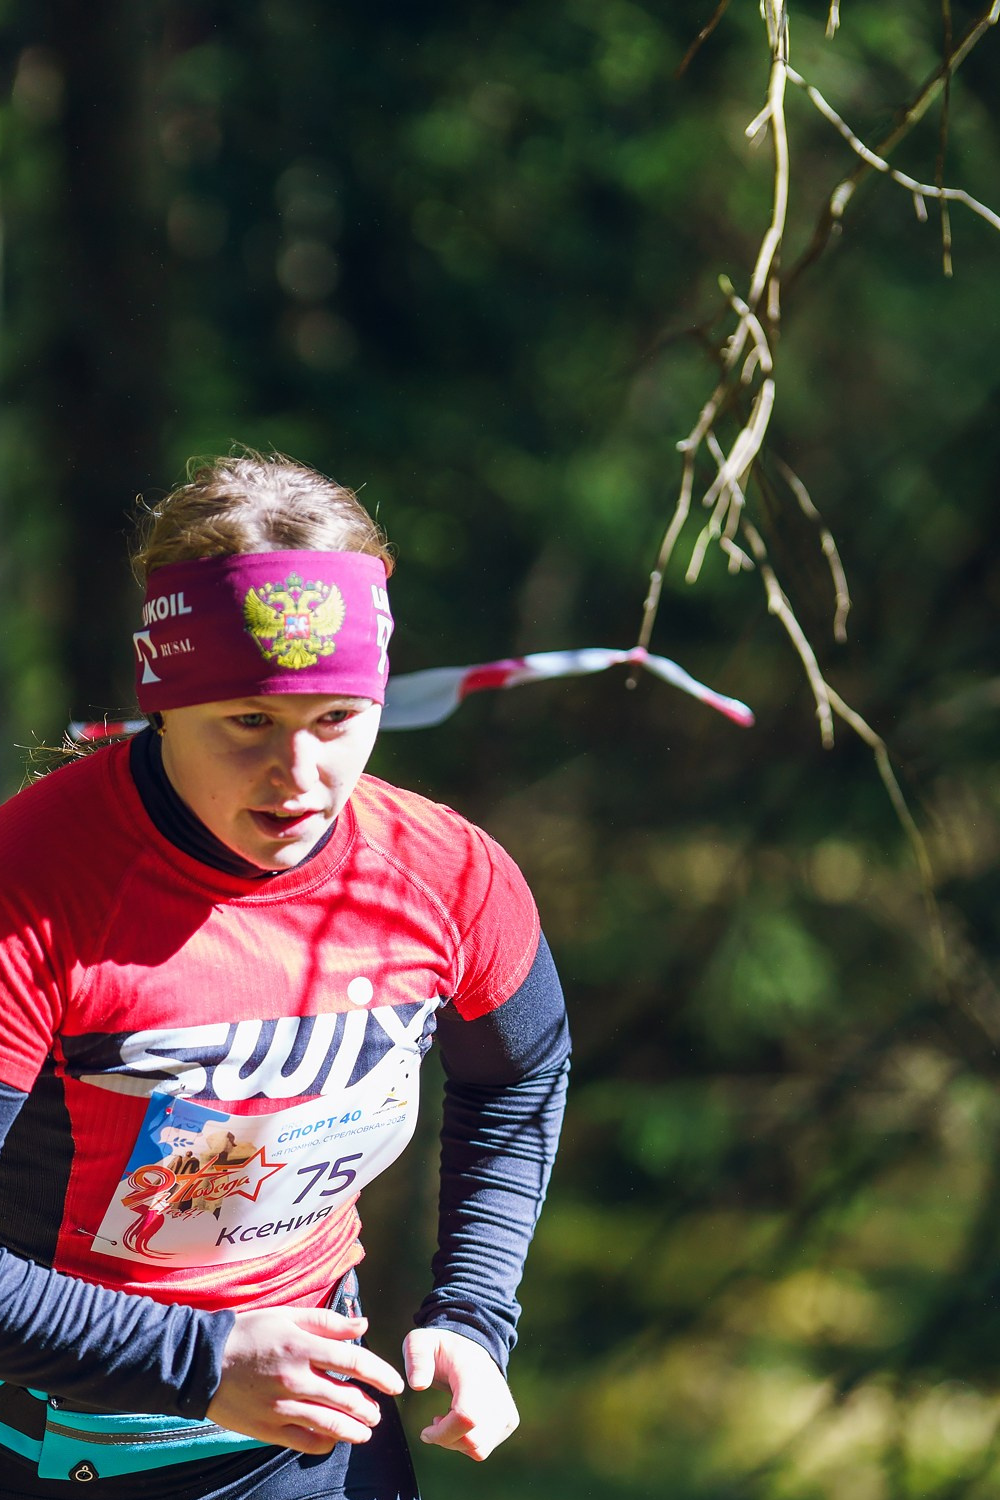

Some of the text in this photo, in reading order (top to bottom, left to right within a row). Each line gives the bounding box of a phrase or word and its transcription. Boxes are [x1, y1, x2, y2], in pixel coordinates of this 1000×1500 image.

[142, 591, 193, 627] UKOIL
[160, 638, 195, 657] RUSAL
[277, 1109, 363, 1144] СПОРТ 40
[386, 1113, 407, 1127] 2025
[292, 1152, 364, 1205] 75
[214, 1204, 334, 1247] Ксения
